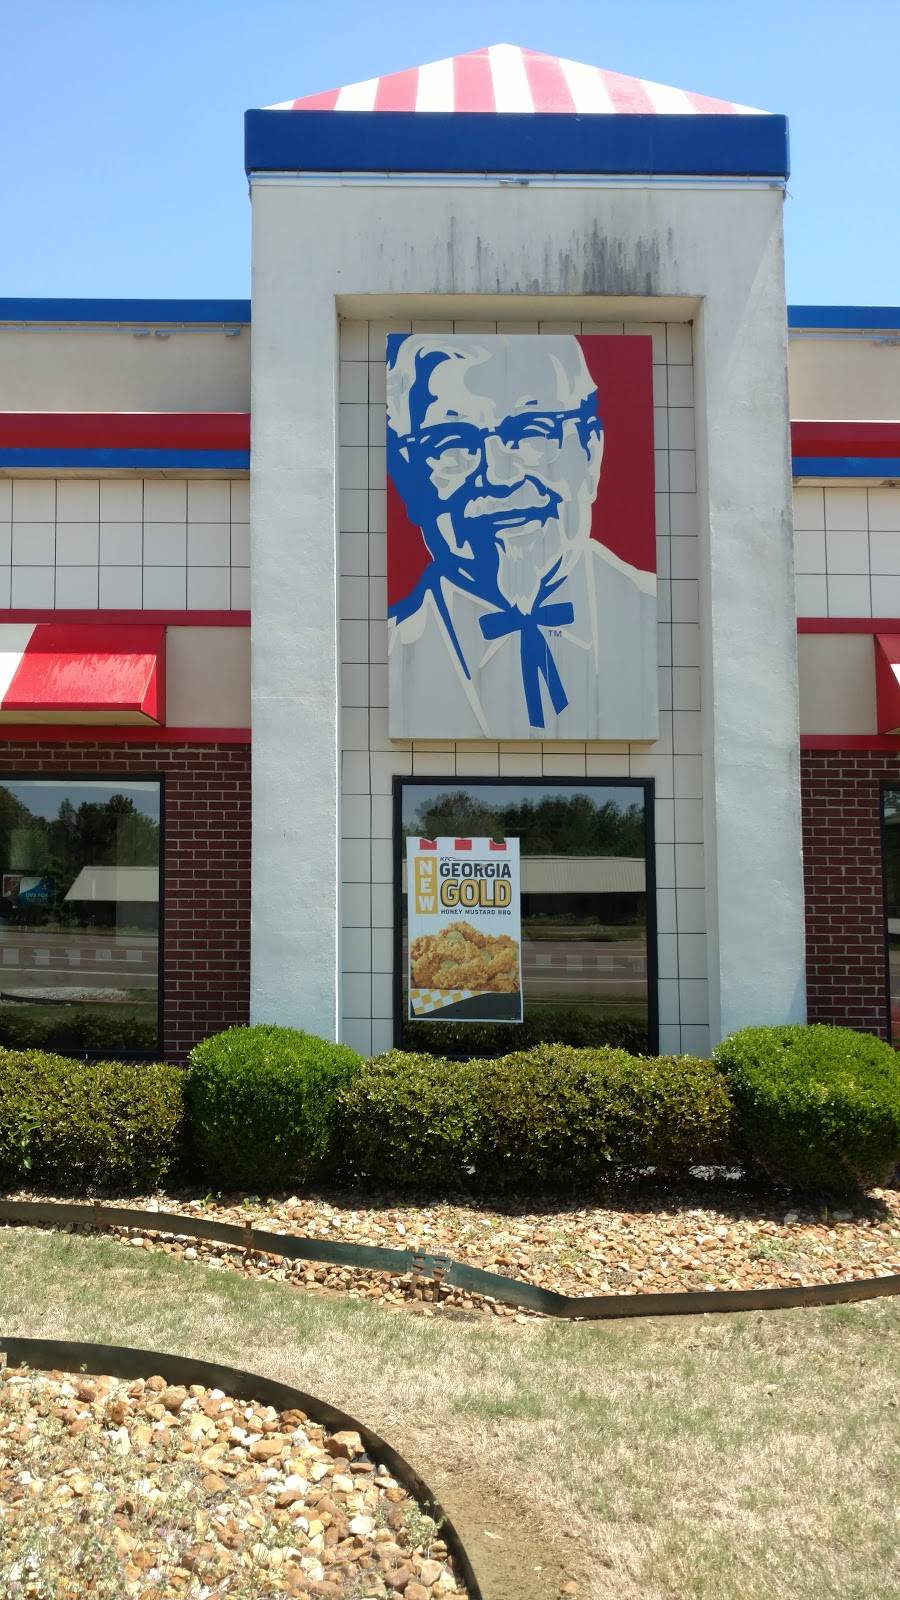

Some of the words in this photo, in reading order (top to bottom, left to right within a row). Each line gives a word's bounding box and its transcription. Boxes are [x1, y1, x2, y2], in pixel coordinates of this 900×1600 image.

[440, 863, 511, 878] GEORGIA
[419, 860, 435, 912] NEW
[440, 879, 512, 908] GOLD
